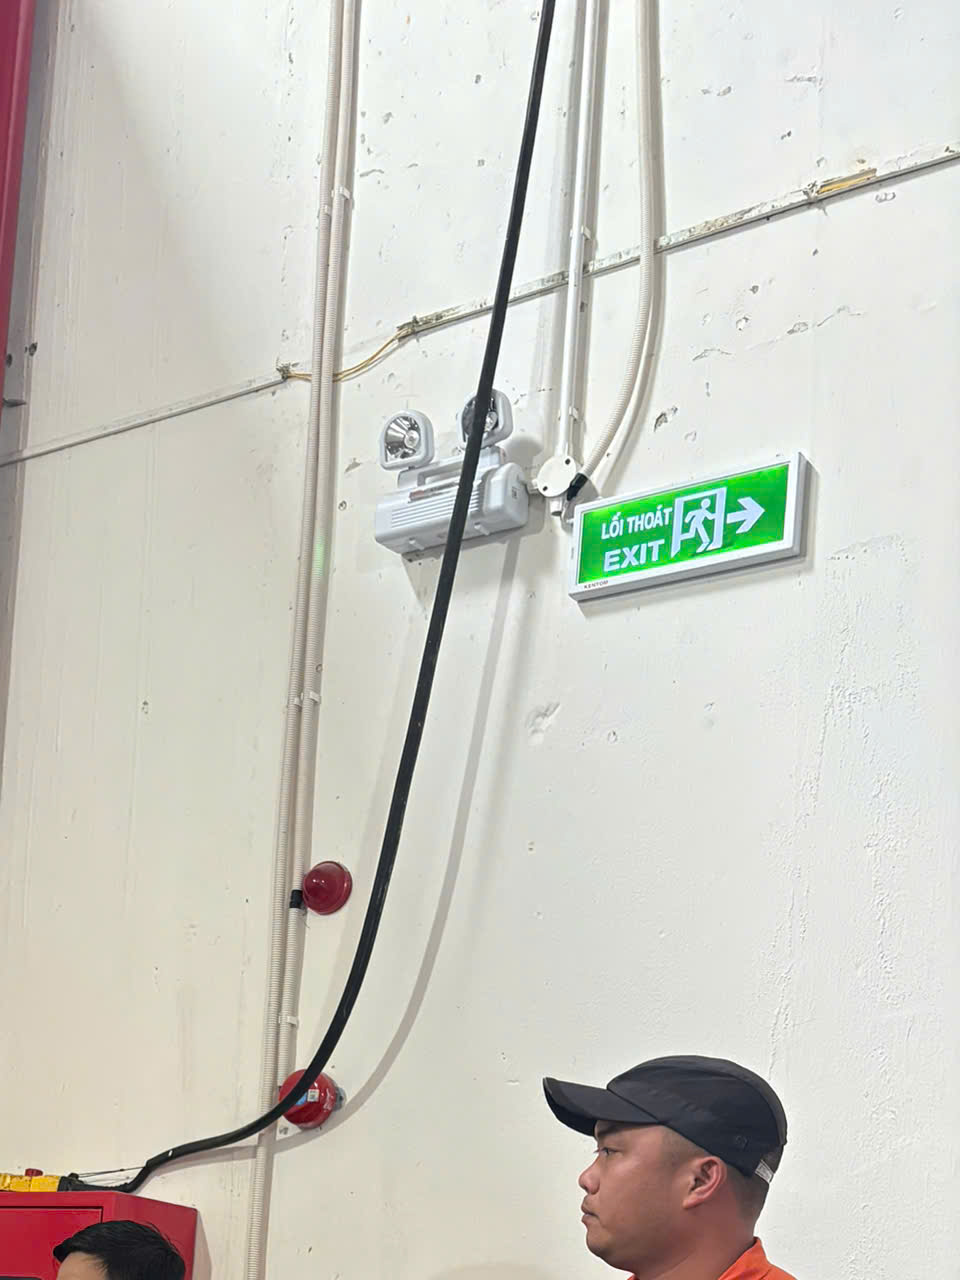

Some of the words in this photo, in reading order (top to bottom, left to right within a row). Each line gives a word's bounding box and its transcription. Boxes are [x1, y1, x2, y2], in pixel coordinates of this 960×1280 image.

[601, 511, 624, 540] LỐI
[626, 504, 673, 534] THOÁT
[604, 539, 665, 571] EXIT
